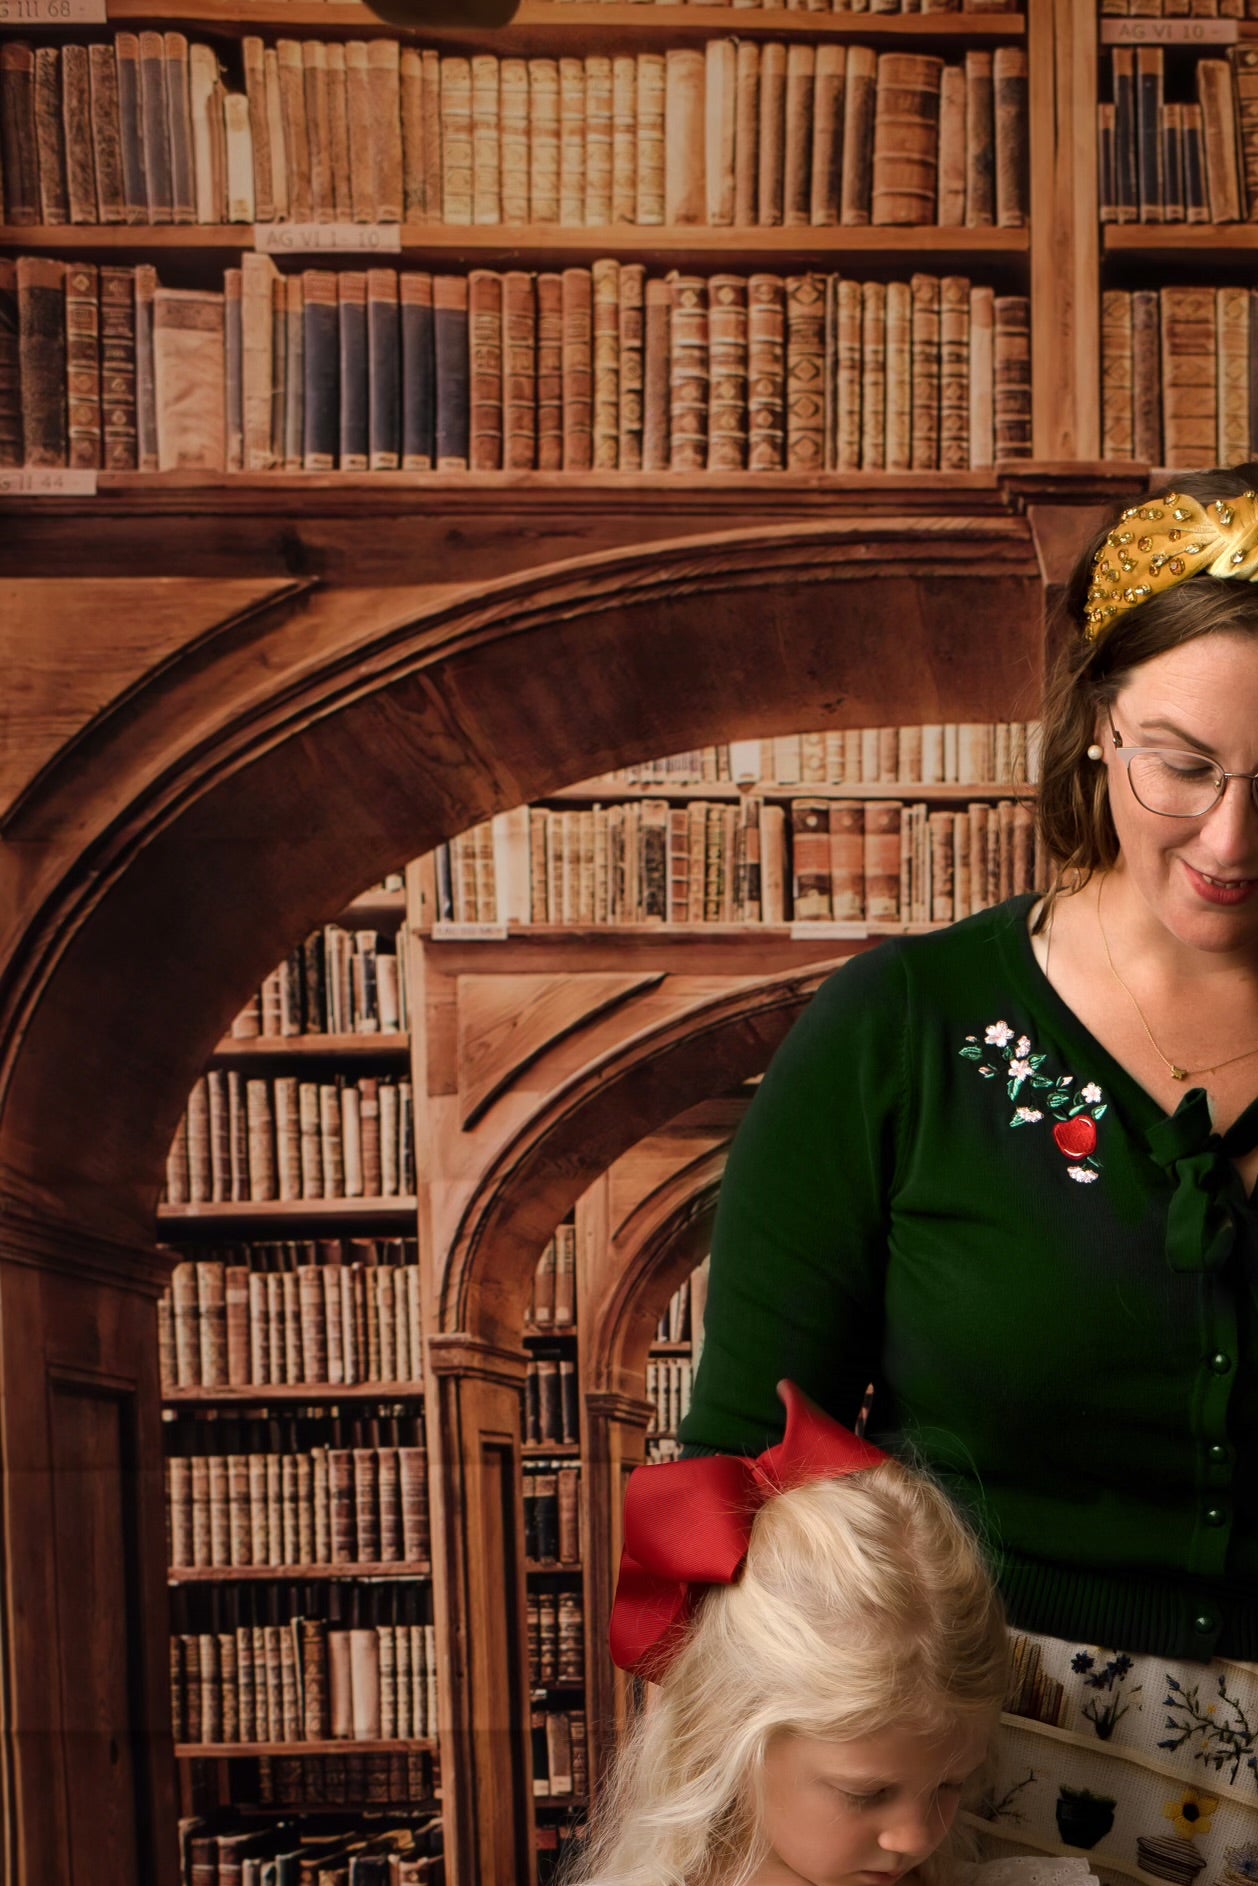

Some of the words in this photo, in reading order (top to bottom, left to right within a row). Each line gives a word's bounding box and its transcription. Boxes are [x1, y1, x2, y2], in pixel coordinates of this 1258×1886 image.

[48, 0, 71, 18] 68
[1119, 23, 1145, 40] AG
[1151, 23, 1173, 39] VI
[1183, 23, 1205, 40] 10
[266, 230, 294, 248] AG
[358, 231, 381, 248] 10
